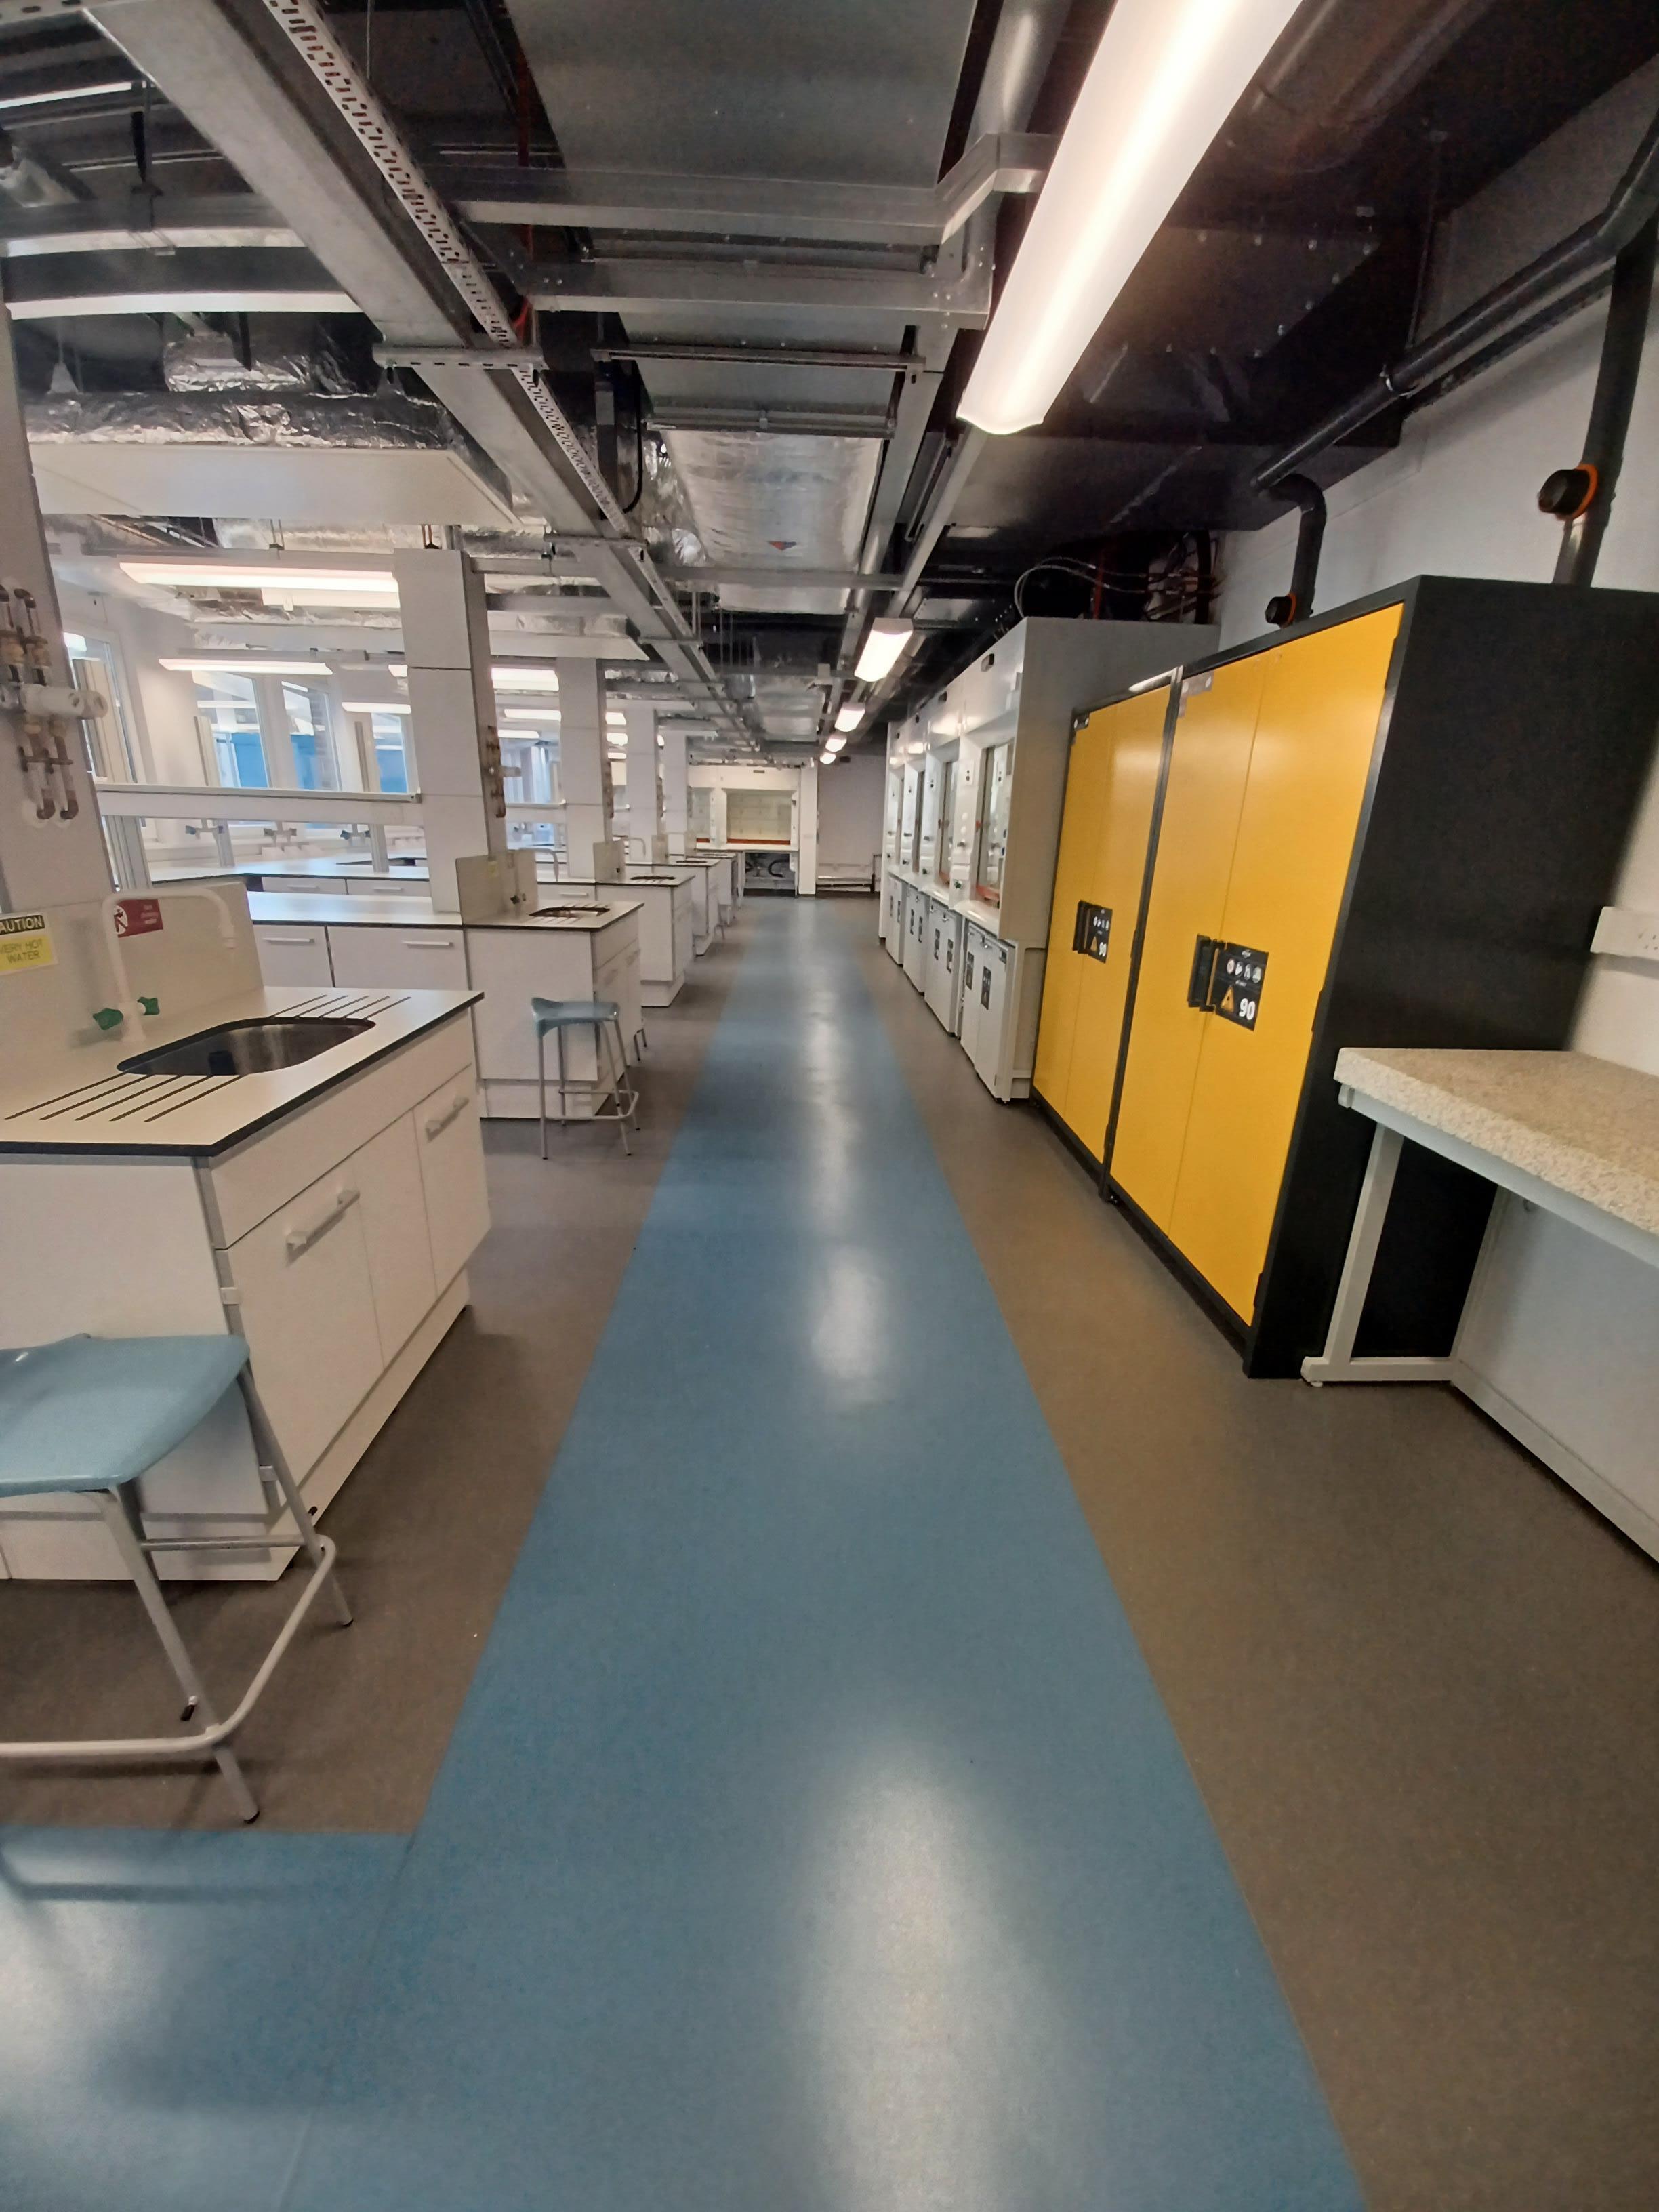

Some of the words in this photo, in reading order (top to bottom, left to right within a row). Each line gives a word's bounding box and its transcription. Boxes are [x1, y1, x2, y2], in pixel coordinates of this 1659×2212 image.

[25, 938, 43, 950] HOT
[7, 949, 40, 963] WATER
[1239, 998, 1256, 1020] 90
